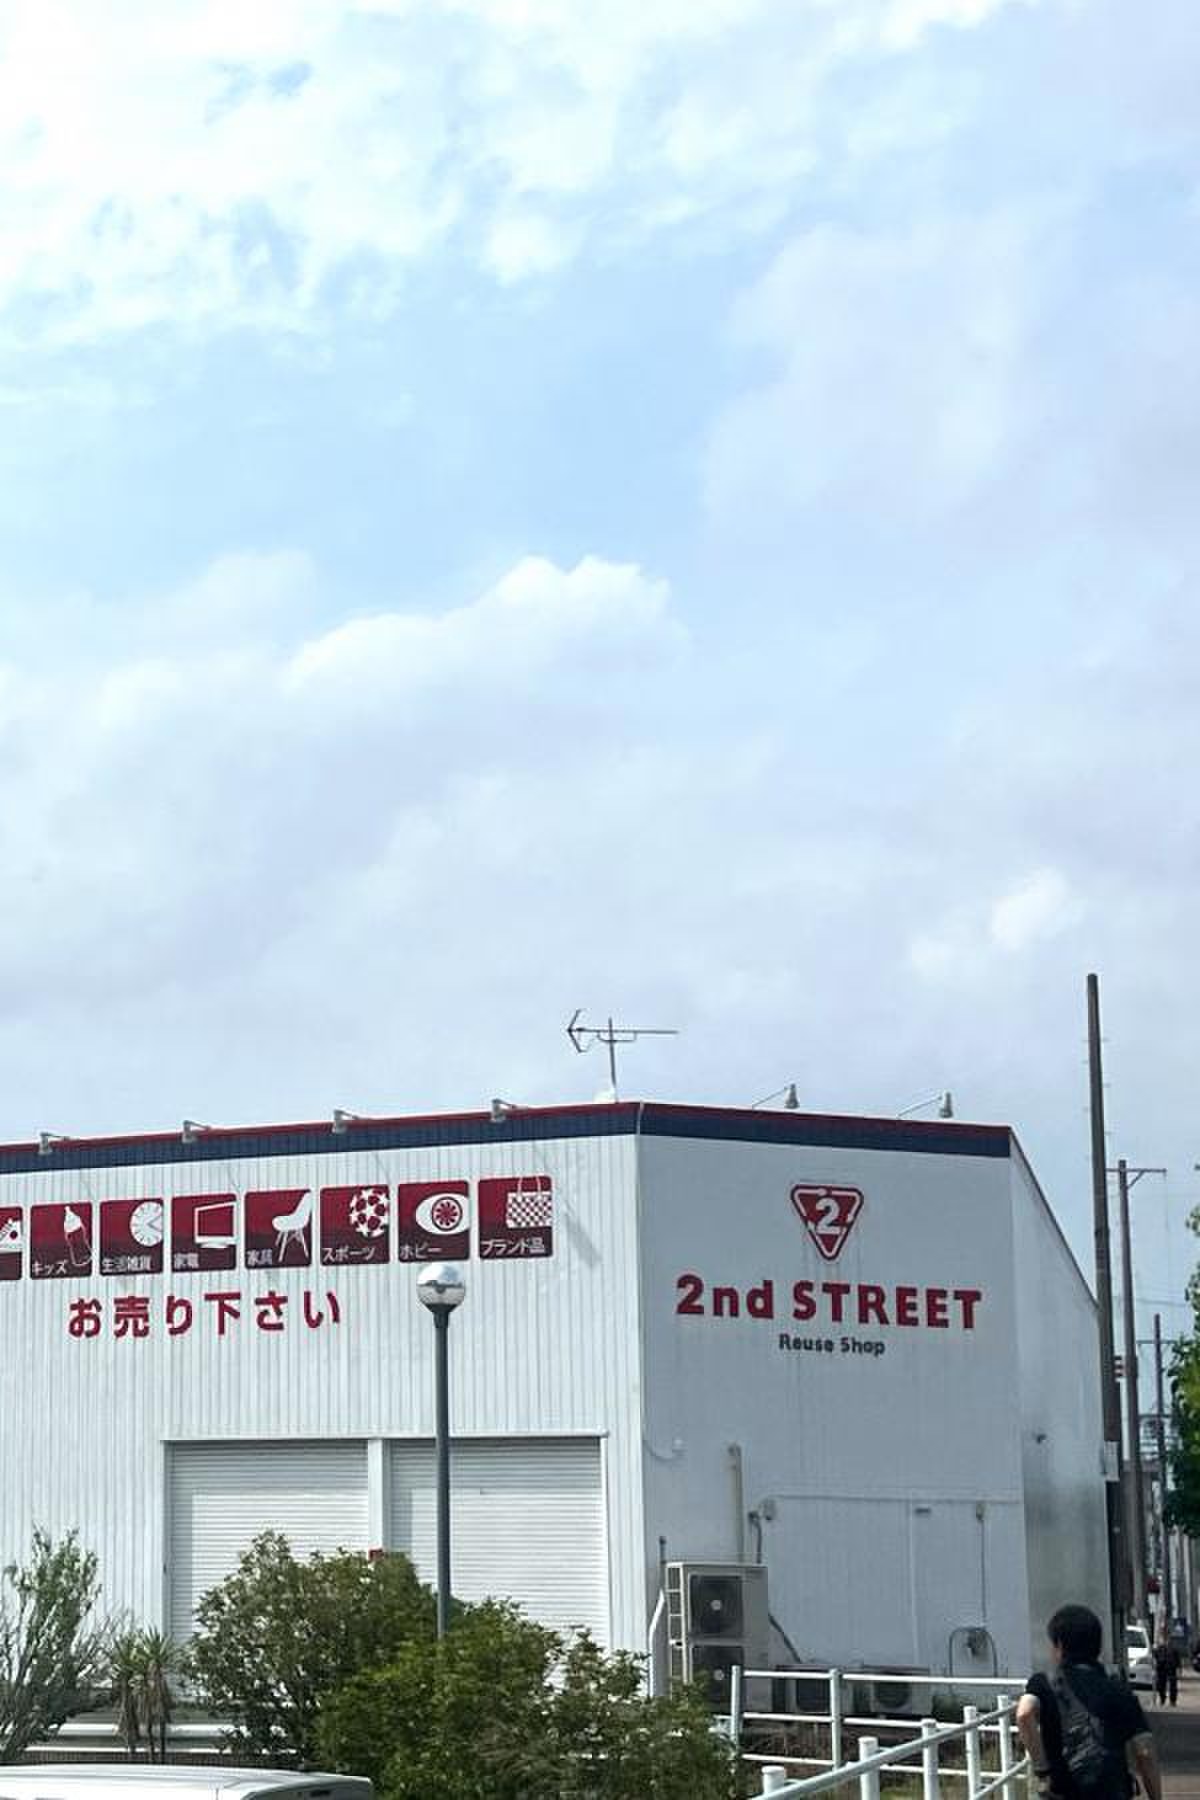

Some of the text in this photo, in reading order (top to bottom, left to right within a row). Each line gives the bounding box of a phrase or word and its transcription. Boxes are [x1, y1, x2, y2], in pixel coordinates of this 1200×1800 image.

[815, 1198, 841, 1235] 2
[322, 1246, 376, 1263] スポーツ
[399, 1244, 442, 1260] ホビー
[31, 1260, 68, 1275] キッズ
[676, 1274, 982, 1329] 2nd STREET
[68, 1290, 341, 1338] お売り下さい
[779, 1333, 886, 1357] Reuse Shop
